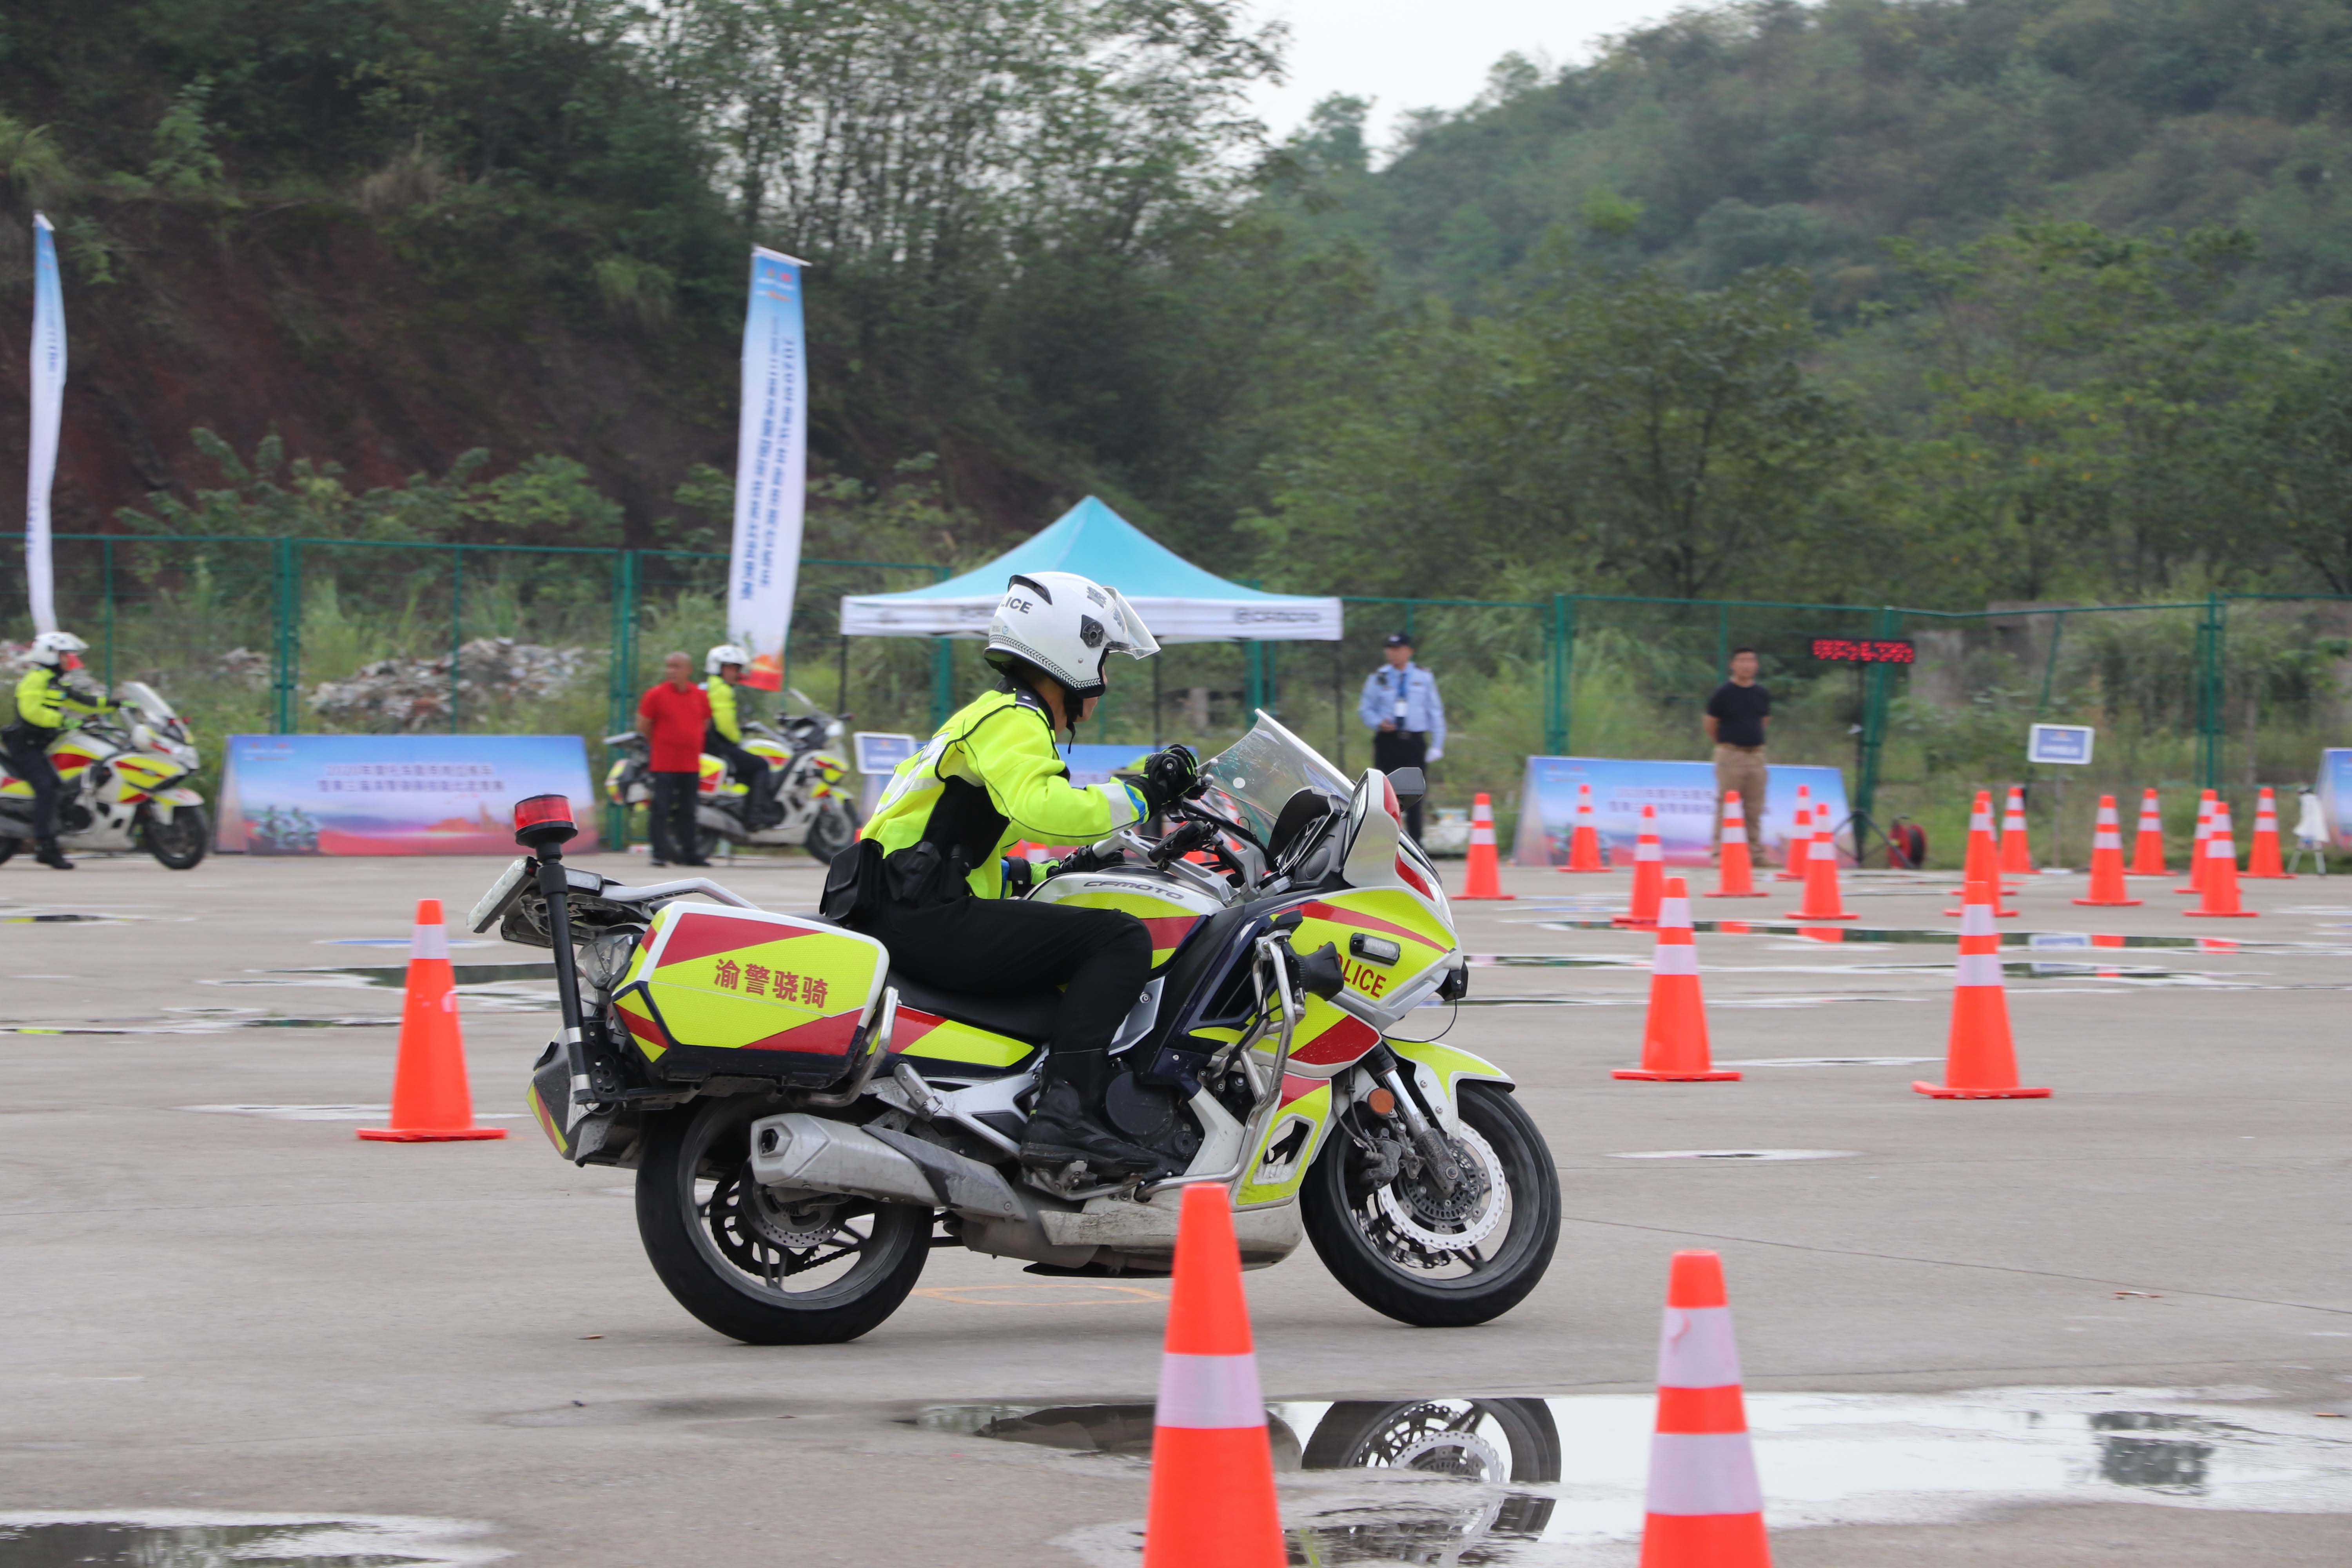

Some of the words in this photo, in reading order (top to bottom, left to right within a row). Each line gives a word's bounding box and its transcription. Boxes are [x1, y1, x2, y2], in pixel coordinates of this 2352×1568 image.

[1083, 882, 1184, 900] CFMOTO
[714, 958, 828, 1008] 渝警骁骑
[1319, 945, 1387, 998] LICE
